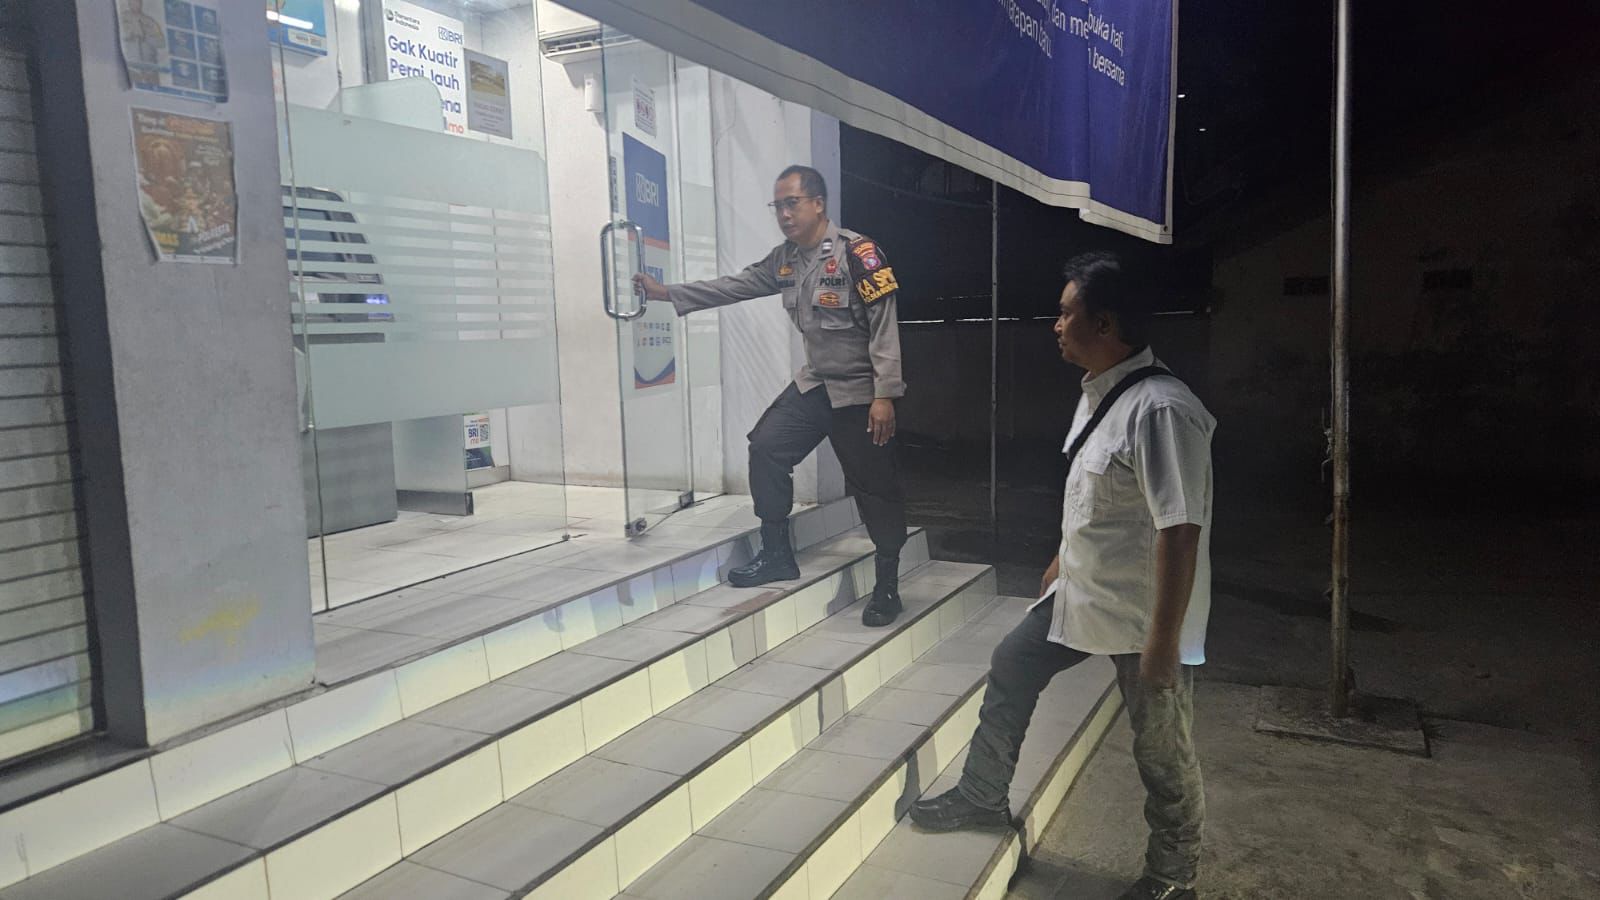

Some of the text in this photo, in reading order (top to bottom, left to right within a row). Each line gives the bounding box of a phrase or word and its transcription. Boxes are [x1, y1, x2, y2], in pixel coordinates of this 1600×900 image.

[447, 30, 463, 45] BRI
[388, 34, 458, 68] Gak Kuatir
[1092, 47, 1125, 87] bersama
[819, 277, 846, 287] POLRI
[468, 427, 479, 438] BRI
